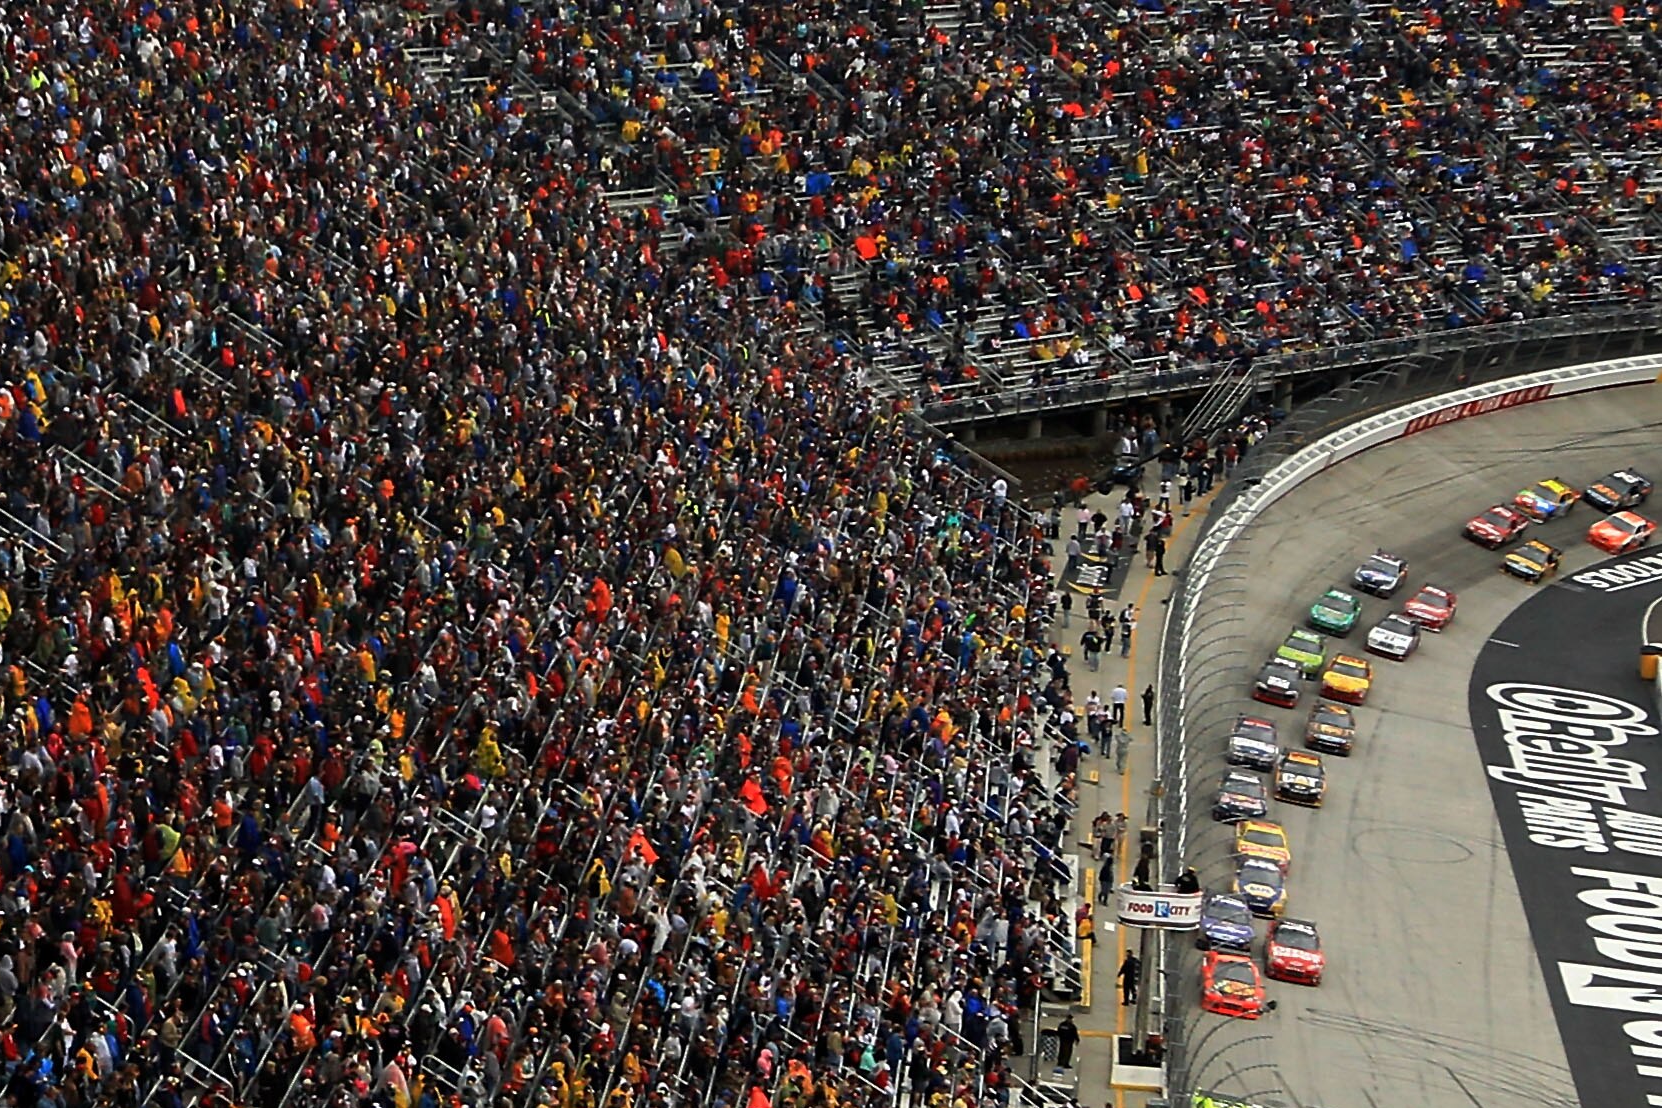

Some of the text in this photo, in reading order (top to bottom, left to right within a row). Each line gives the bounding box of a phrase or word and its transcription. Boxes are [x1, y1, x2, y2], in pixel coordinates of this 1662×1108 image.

[1516, 791, 1609, 852] PARTS
[1127, 902, 1154, 914] FOOD
[1170, 905, 1191, 916] CITY
